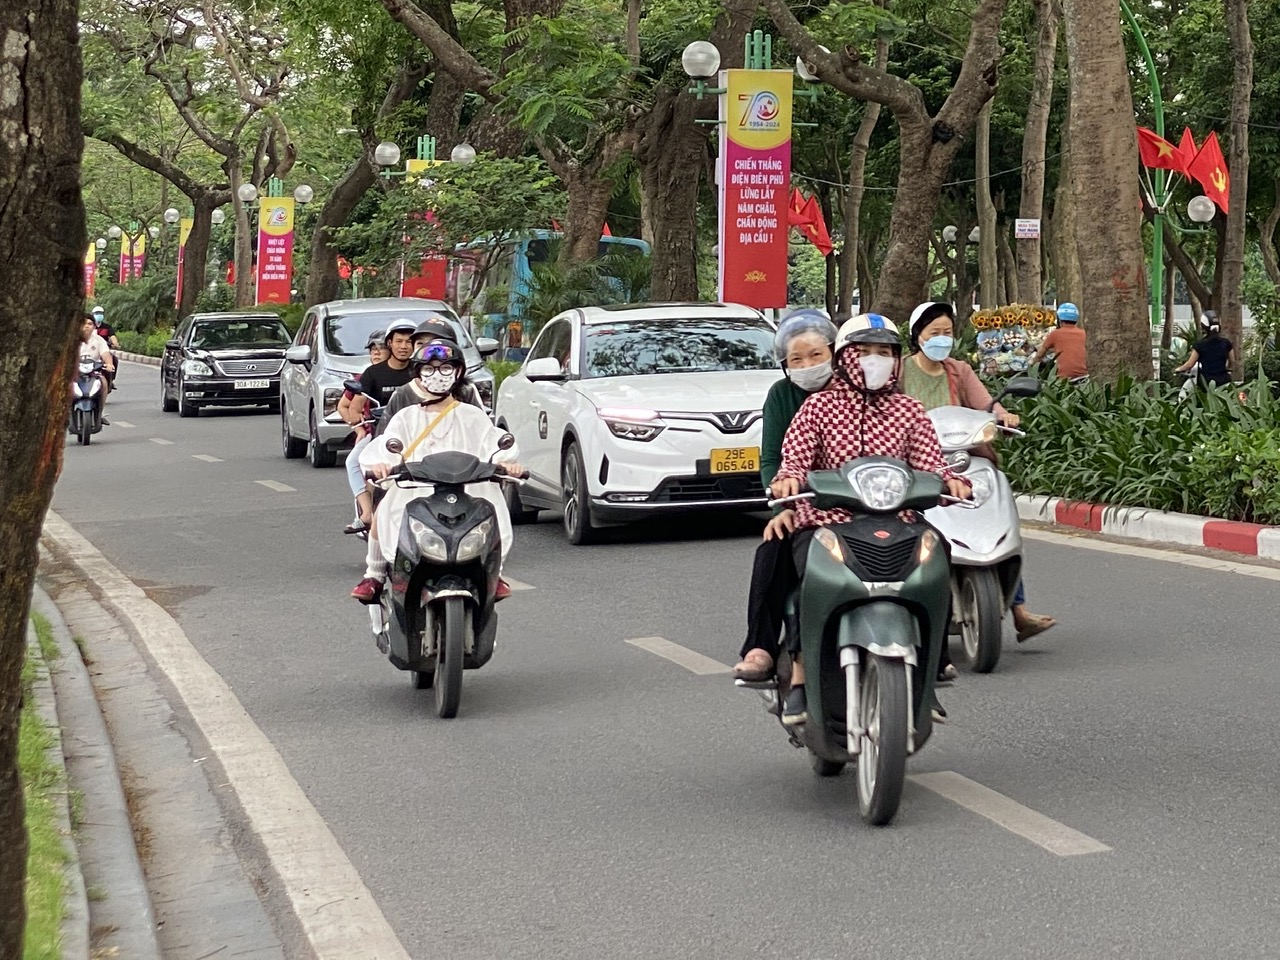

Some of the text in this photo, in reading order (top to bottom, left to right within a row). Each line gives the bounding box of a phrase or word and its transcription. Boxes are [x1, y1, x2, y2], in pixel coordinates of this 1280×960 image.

[734, 156, 782, 170] CHIẾN THẮNG
[731, 171, 784, 186] ĐIỆN BIÊN PHỦ
[737, 201, 777, 216] NĂM CHÂU,
[725, 448, 746, 460] 29E
[716, 459, 754, 471] 065.48
